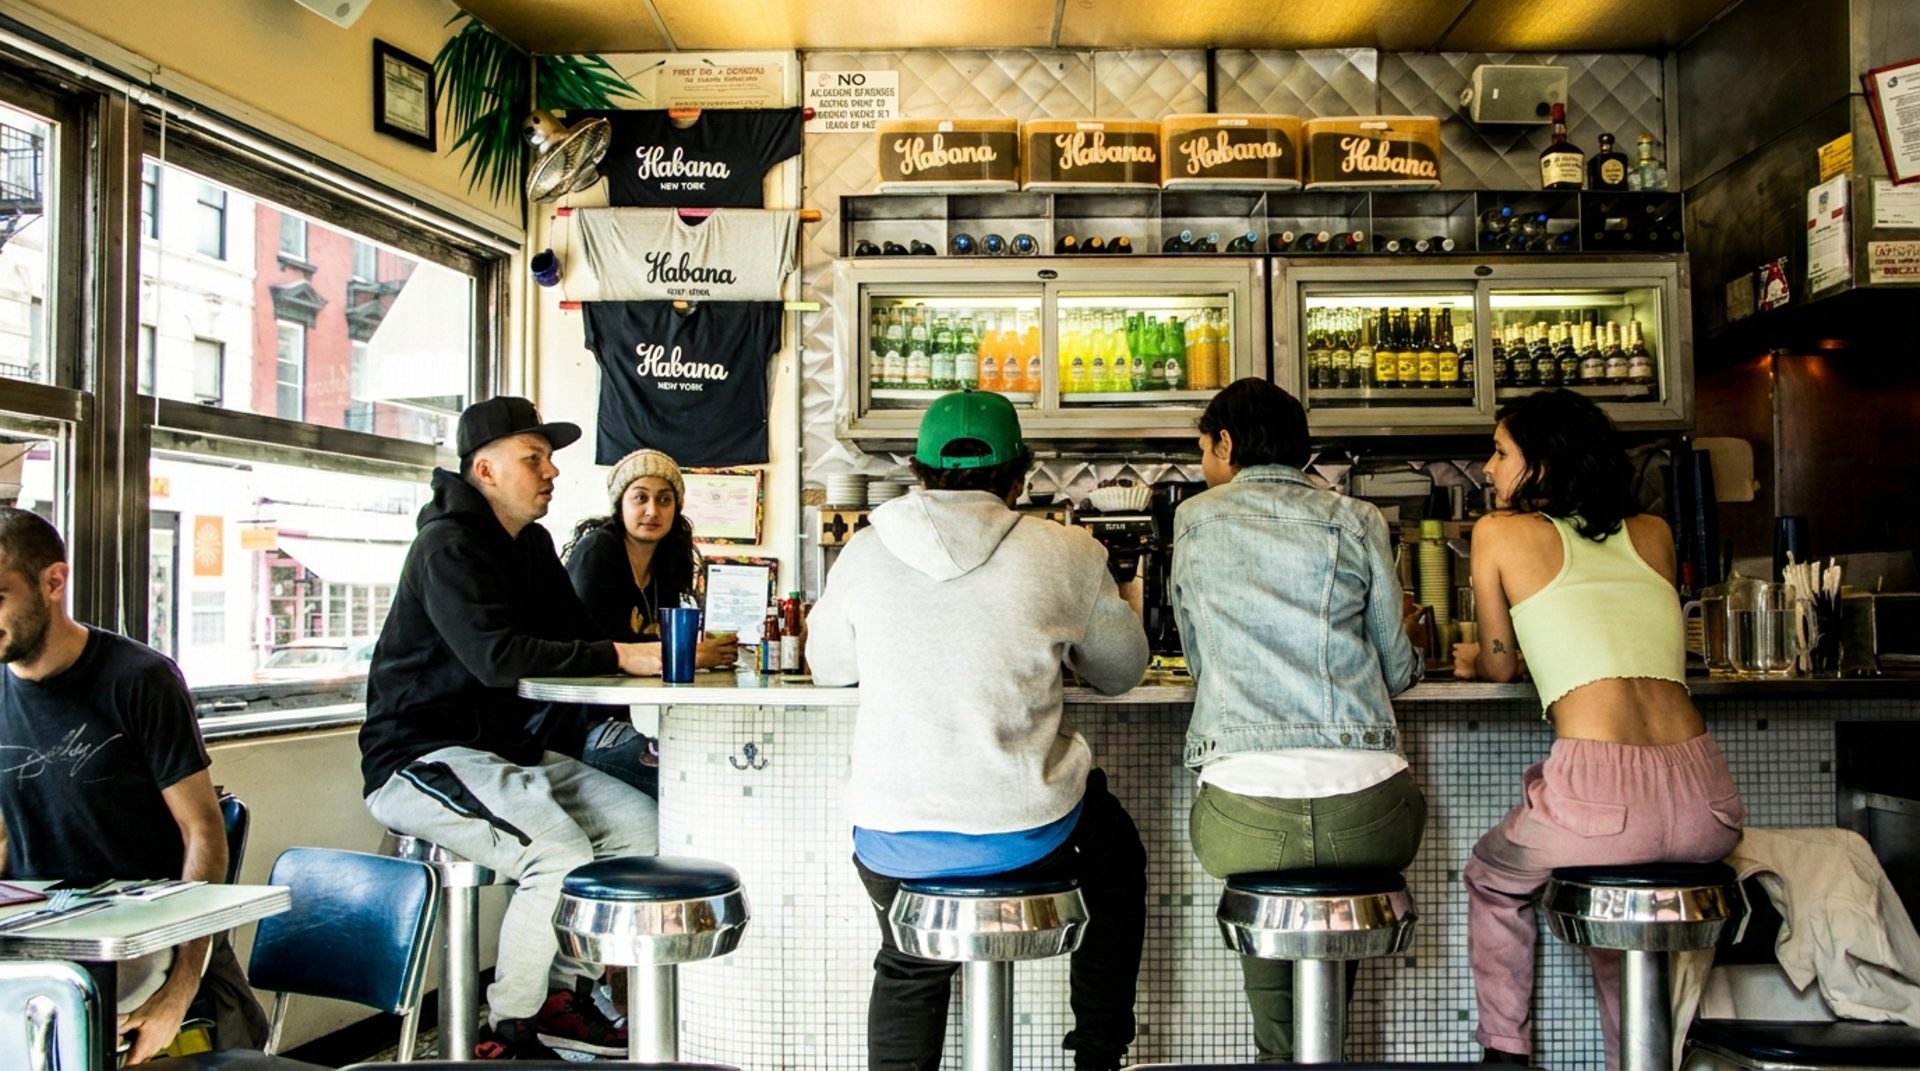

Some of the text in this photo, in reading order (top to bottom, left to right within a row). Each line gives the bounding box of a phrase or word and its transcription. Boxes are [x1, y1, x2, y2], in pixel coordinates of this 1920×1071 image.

[838, 73, 866, 86] NO
[635, 145, 731, 180] Habana
[894, 134, 997, 175] Habana
[1055, 131, 1156, 170] Habana
[1179, 130, 1283, 175] Habana
[1340, 137, 1437, 178] Habana
[660, 182, 679, 191] NEW
[644, 251, 737, 285] Habana
[635, 342, 729, 381] Habana
[657, 382, 704, 392] NEW YORK
